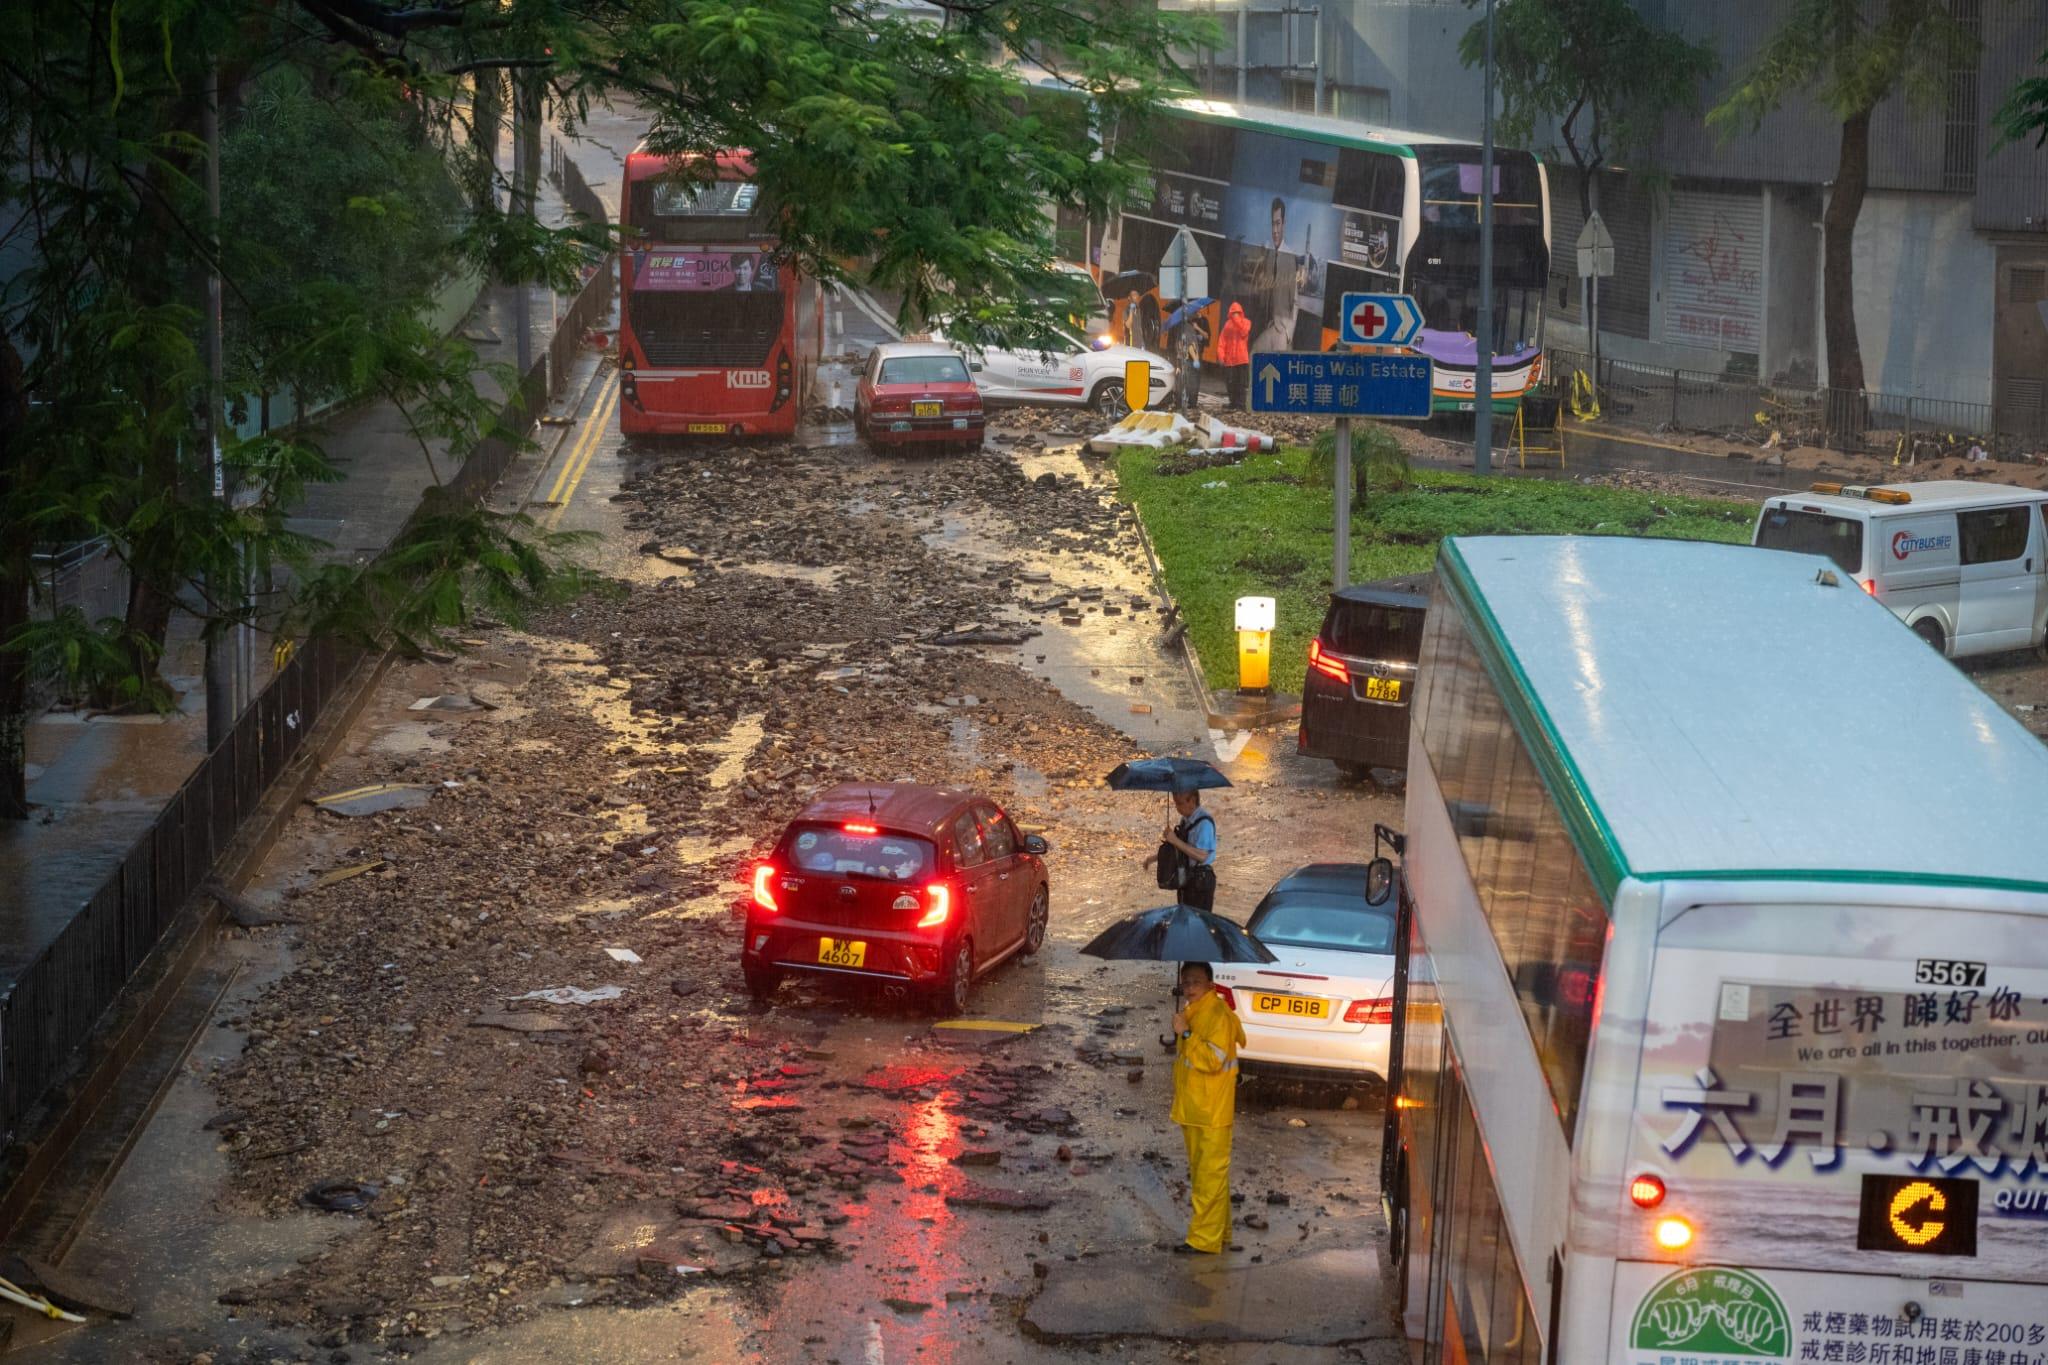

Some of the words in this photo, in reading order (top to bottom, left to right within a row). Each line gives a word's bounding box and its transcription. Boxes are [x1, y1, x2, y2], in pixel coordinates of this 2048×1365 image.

[696, 259, 730, 273] DICK
[1288, 360, 1324, 378] Hing
[1330, 361, 1365, 377] Wah
[1371, 362, 1426, 379] Estate
[726, 370, 771, 389] KMB
[1288, 383, 1360, 408] 興華邨
[1901, 537, 1936, 551] CITYBUS
[1368, 687, 1398, 700] 7789
[1376, 679, 1391, 690] CC
[821, 950, 860, 965] 4607
[1917, 960, 1986, 986] 5567
[1260, 996, 1281, 1010] CP
[1288, 999, 1321, 1015] 1618
[1767, 995, 1886, 1040] 全世界
[1902, 985, 2023, 1029] 睇好你
[1798, 1047, 1824, 1061] We
[1828, 1047, 1857, 1058] are
[1862, 1042, 1882, 1056] all
[1886, 1040, 1901, 1053] in
[1906, 1037, 1938, 1051] this
[1942, 1032, 2020, 1053] together.
[1994, 1188, 2048, 1211] QUI
